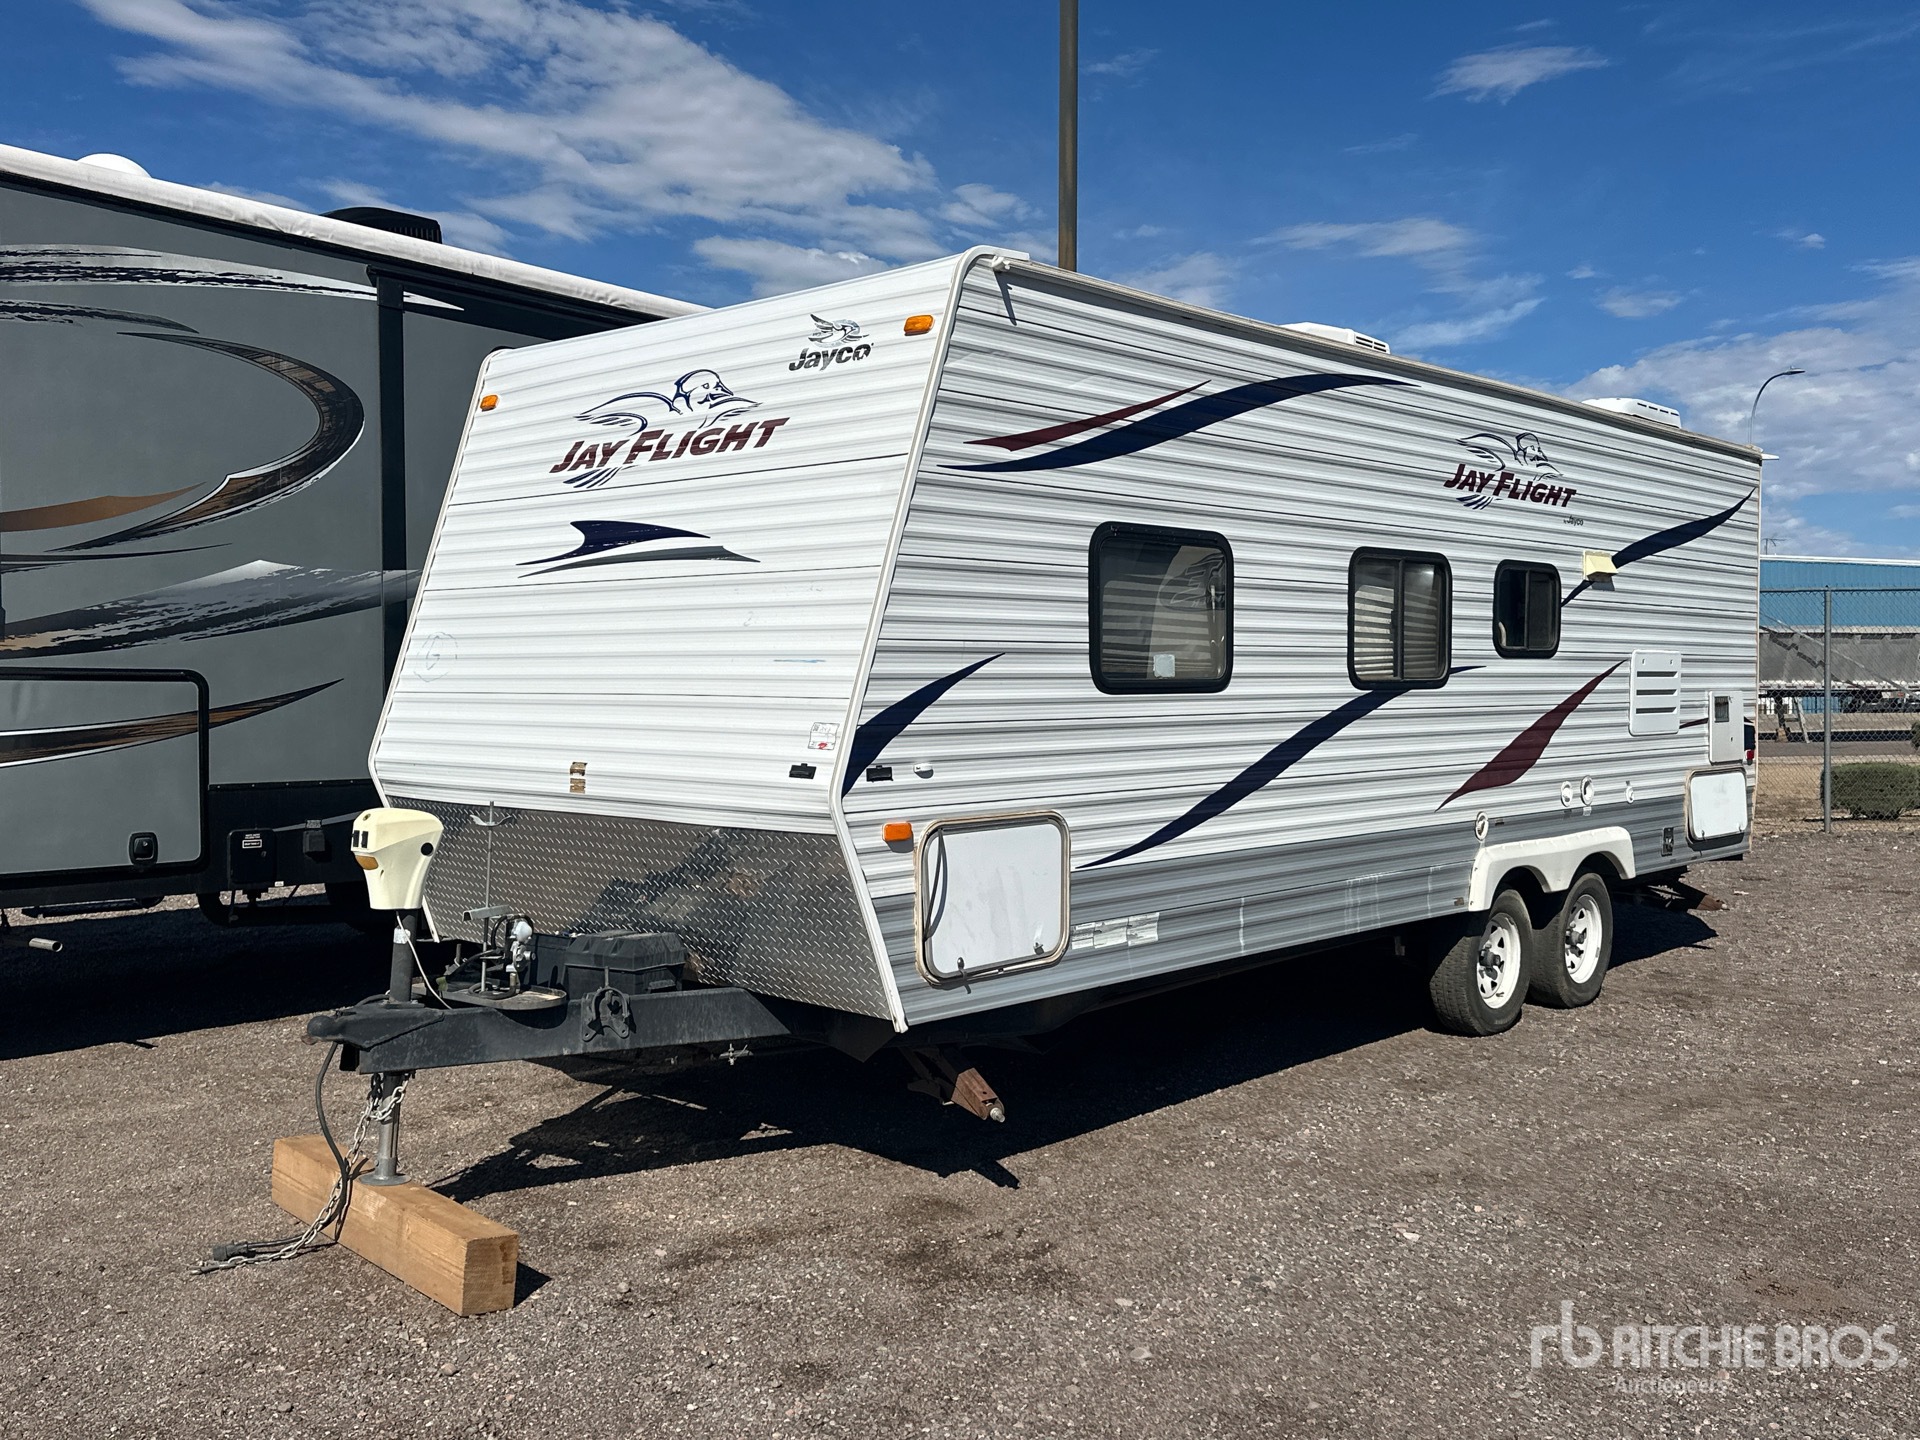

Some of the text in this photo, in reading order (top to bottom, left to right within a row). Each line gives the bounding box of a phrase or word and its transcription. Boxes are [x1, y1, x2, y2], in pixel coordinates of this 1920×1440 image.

[788, 344, 871, 371] Jayco
[549, 417, 790, 473] JAY FLIGHT
[1443, 463, 1577, 508] JAY FLIGHT
